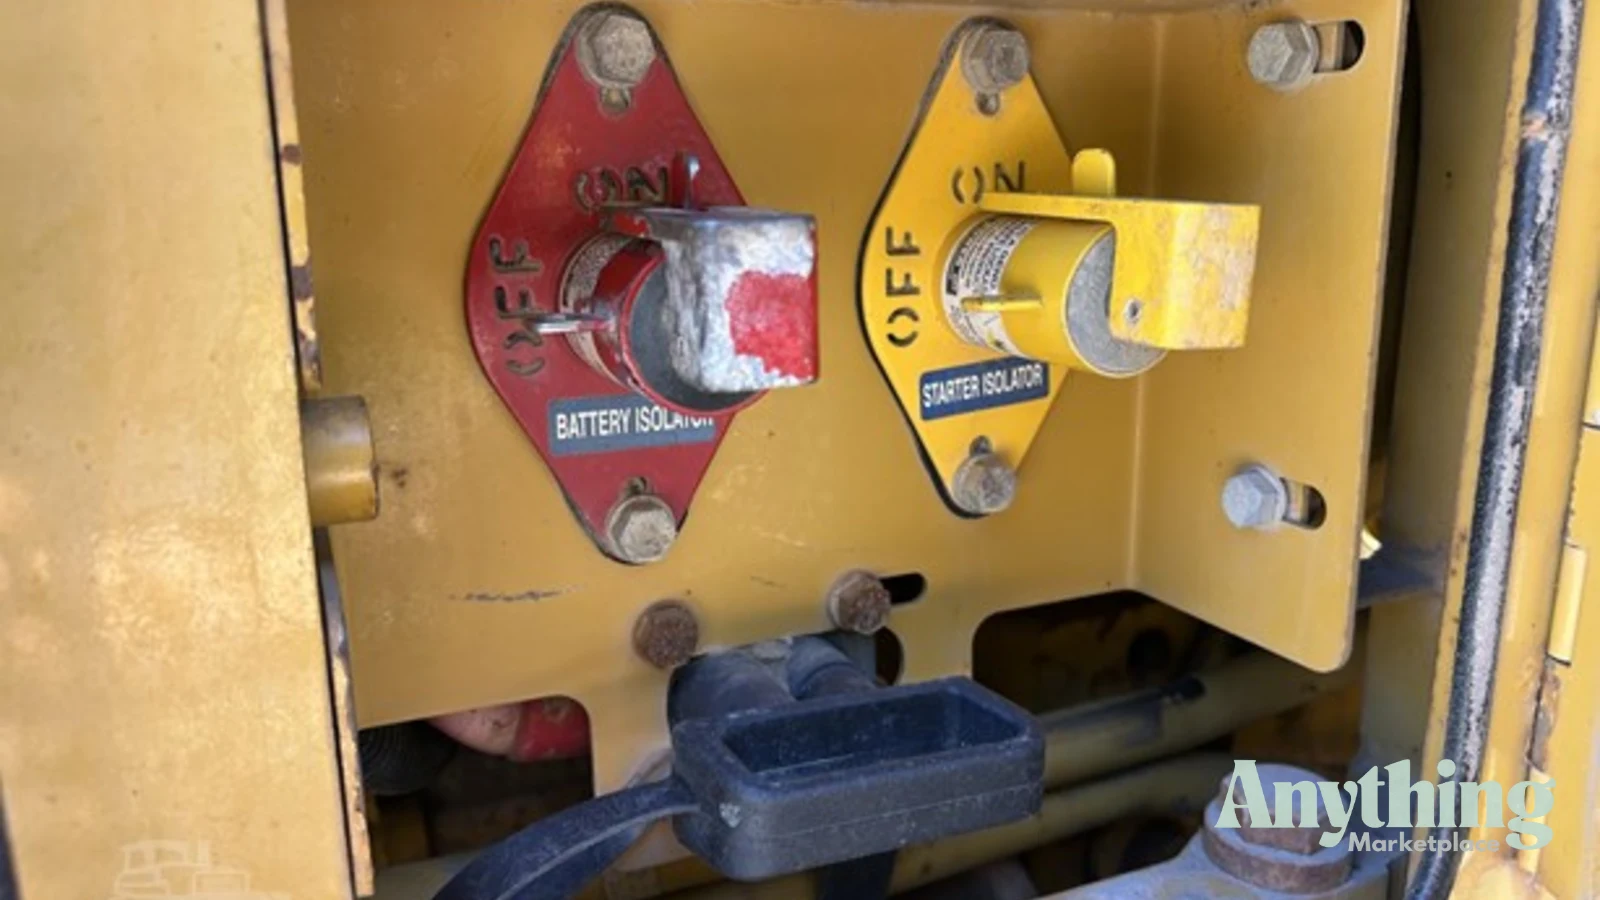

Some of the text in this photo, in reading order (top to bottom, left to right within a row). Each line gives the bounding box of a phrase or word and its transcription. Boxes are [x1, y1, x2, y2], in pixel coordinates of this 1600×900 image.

[574, 165, 669, 212] ON
[953, 160, 1026, 204] ON
[489, 236, 544, 378] OFF
[884, 226, 921, 348] OFF
[922, 363, 1044, 408] STARTER ISOLATOR
[556, 407, 632, 440] BATTERY
